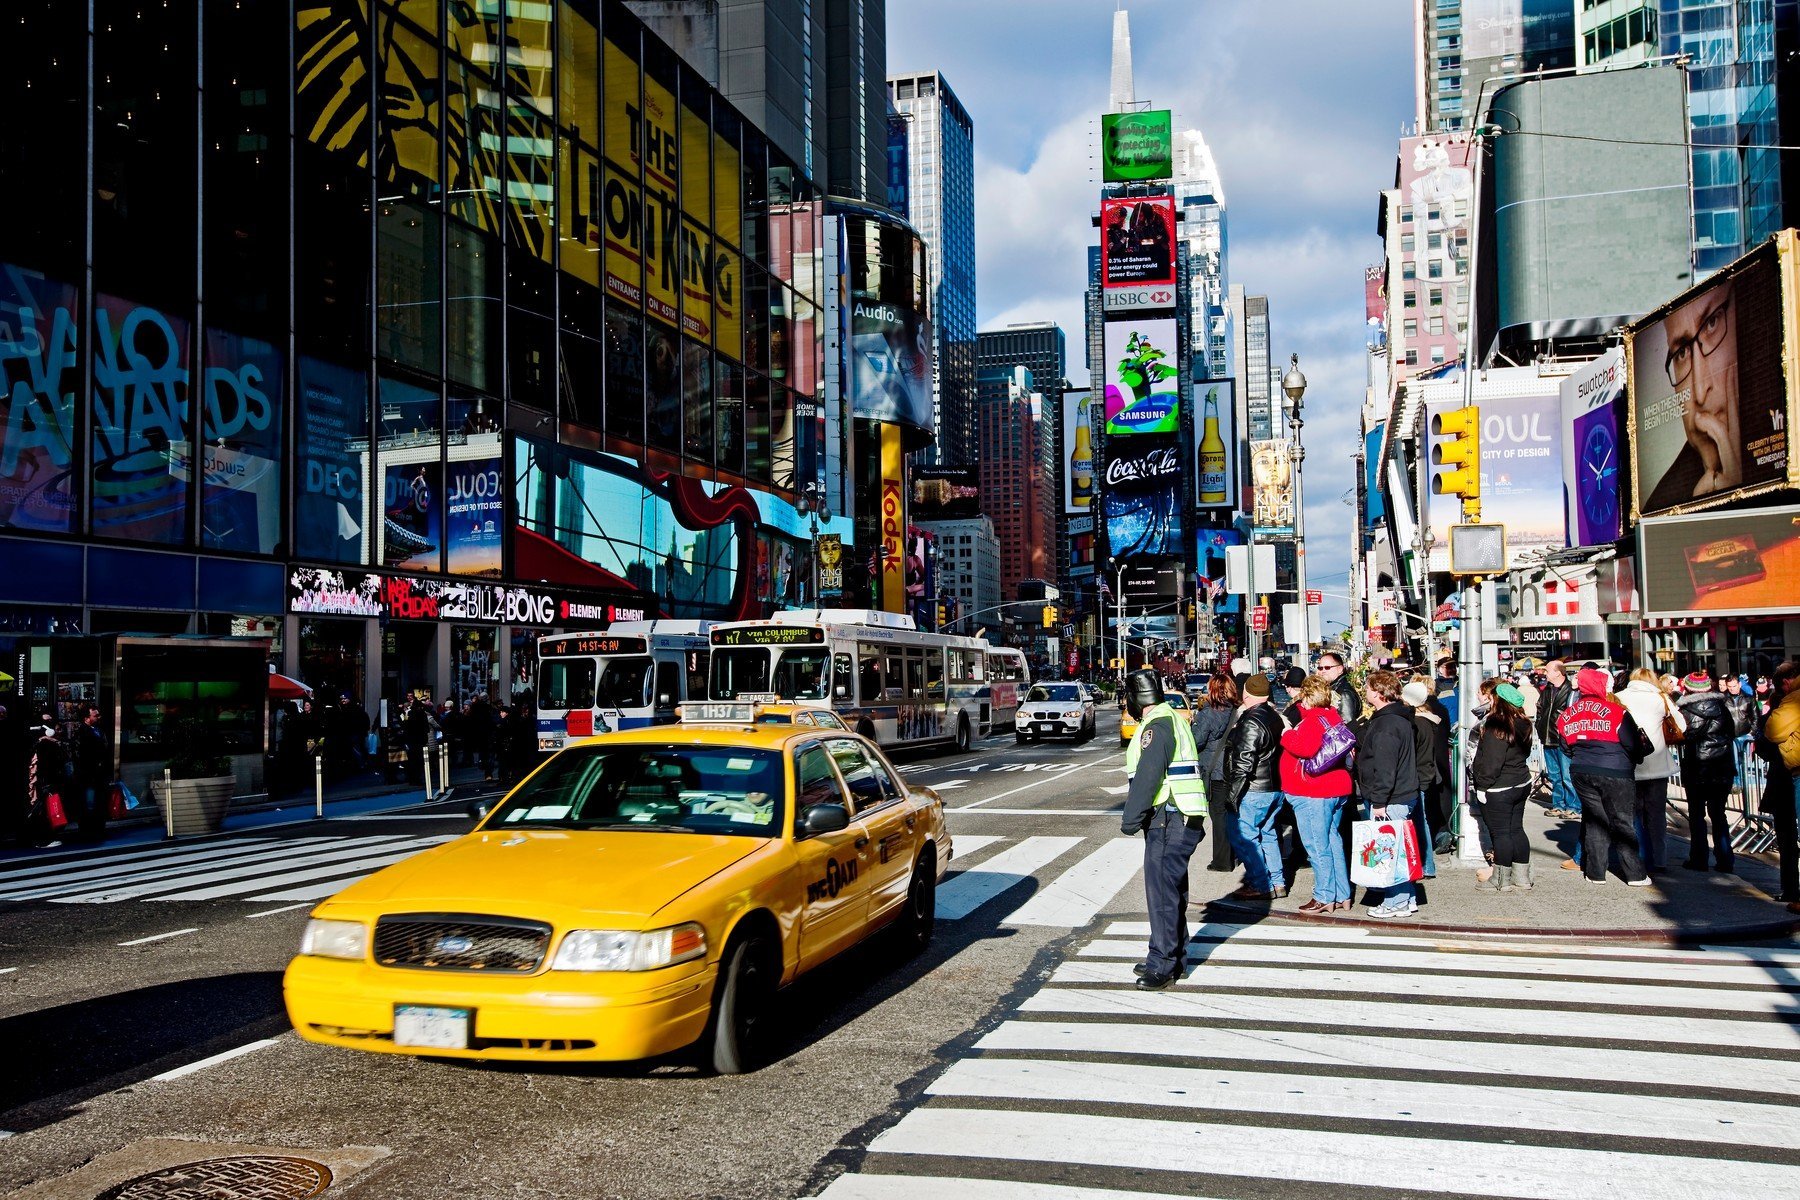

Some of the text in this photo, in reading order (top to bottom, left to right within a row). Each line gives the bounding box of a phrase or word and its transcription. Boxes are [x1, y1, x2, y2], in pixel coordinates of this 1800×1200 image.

[625, 102, 676, 181] THE
[570, 123, 655, 261] LION
[661, 188, 732, 306] KING
[608, 275, 641, 301] ENTRANCE
[648, 297, 659, 311] ON
[661, 305, 677, 319] 45TH
[682, 316, 700, 332] STREET
[1106, 292, 1149, 306] HSBC
[1578, 369, 1609, 398] swatch
[1643, 388, 1690, 419] WHEN THE STARS
[1119, 410, 1166, 420] SAMSUNG
[1661, 410, 1669, 423] TO
[1479, 412, 1552, 444] OUL
[1482, 447, 1550, 459] CITY OF DESIGN
[1256, 494, 1291, 505] KING
[1257, 506, 1290, 520] TUT
[883, 478, 900, 573] Kodak
[820, 568, 842, 577] KING
[391, 596, 438, 619] HOLIDAYS
[466, 586, 554, 624] BILLABONG
[569, 604, 602, 620] ELEMENT
[615, 608, 645, 621] ELEMENT
[726, 631, 741, 644] M7
[765, 629, 809, 637] COLUMBUS
[1523, 628, 1560, 641] swatch
[556, 640, 619, 654] M7 14 ST-6 AV
[17, 653, 25, 697] Newsstand
[700, 704, 734, 718] 1H37
[1562, 701, 1611, 723] EASTON
[1563, 718, 1611, 737] WRETLING
